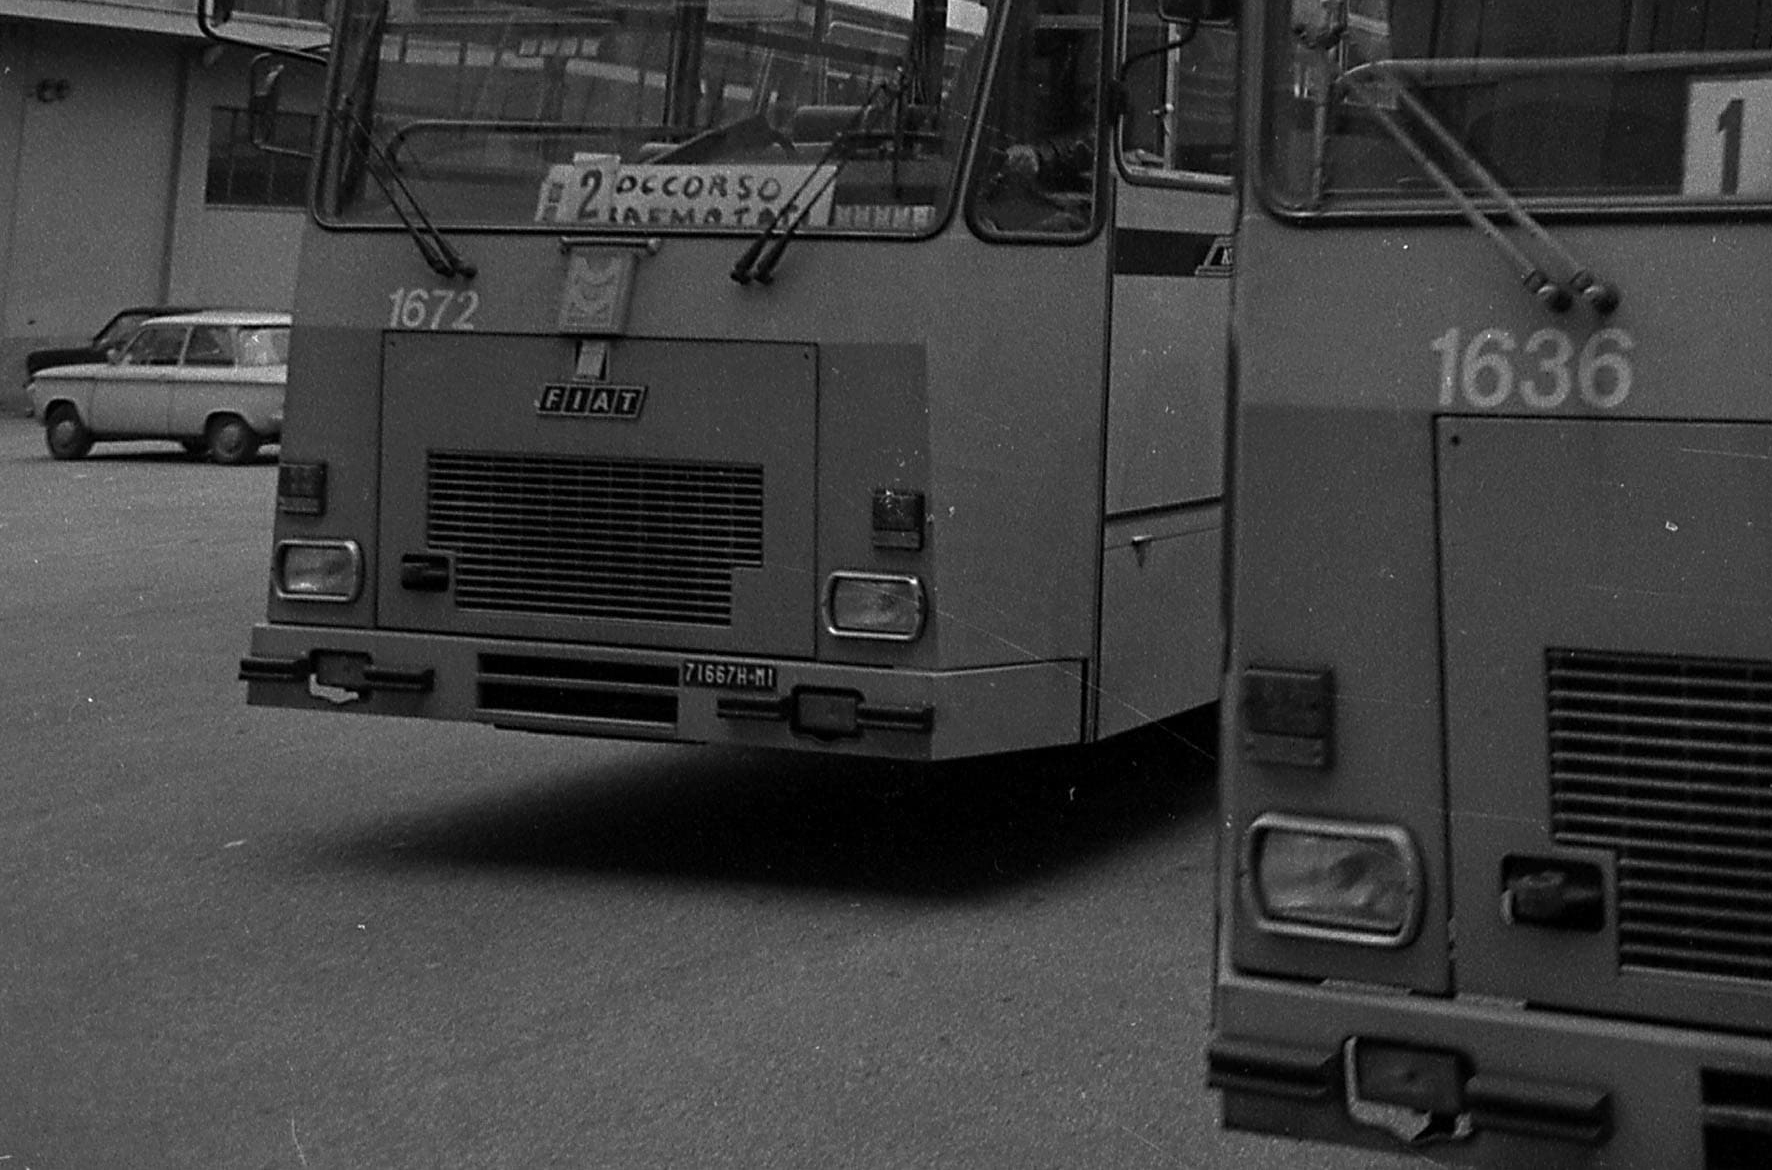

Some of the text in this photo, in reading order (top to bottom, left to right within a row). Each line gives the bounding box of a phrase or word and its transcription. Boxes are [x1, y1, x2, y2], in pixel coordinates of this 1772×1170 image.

[1716, 96, 1746, 196] 1
[577, 168, 603, 222] 2
[615, 174, 782, 202] OCCORSO
[388, 286, 480, 330] 1672
[1430, 328, 1636, 410] 1636
[544, 387, 638, 413] FIAT
